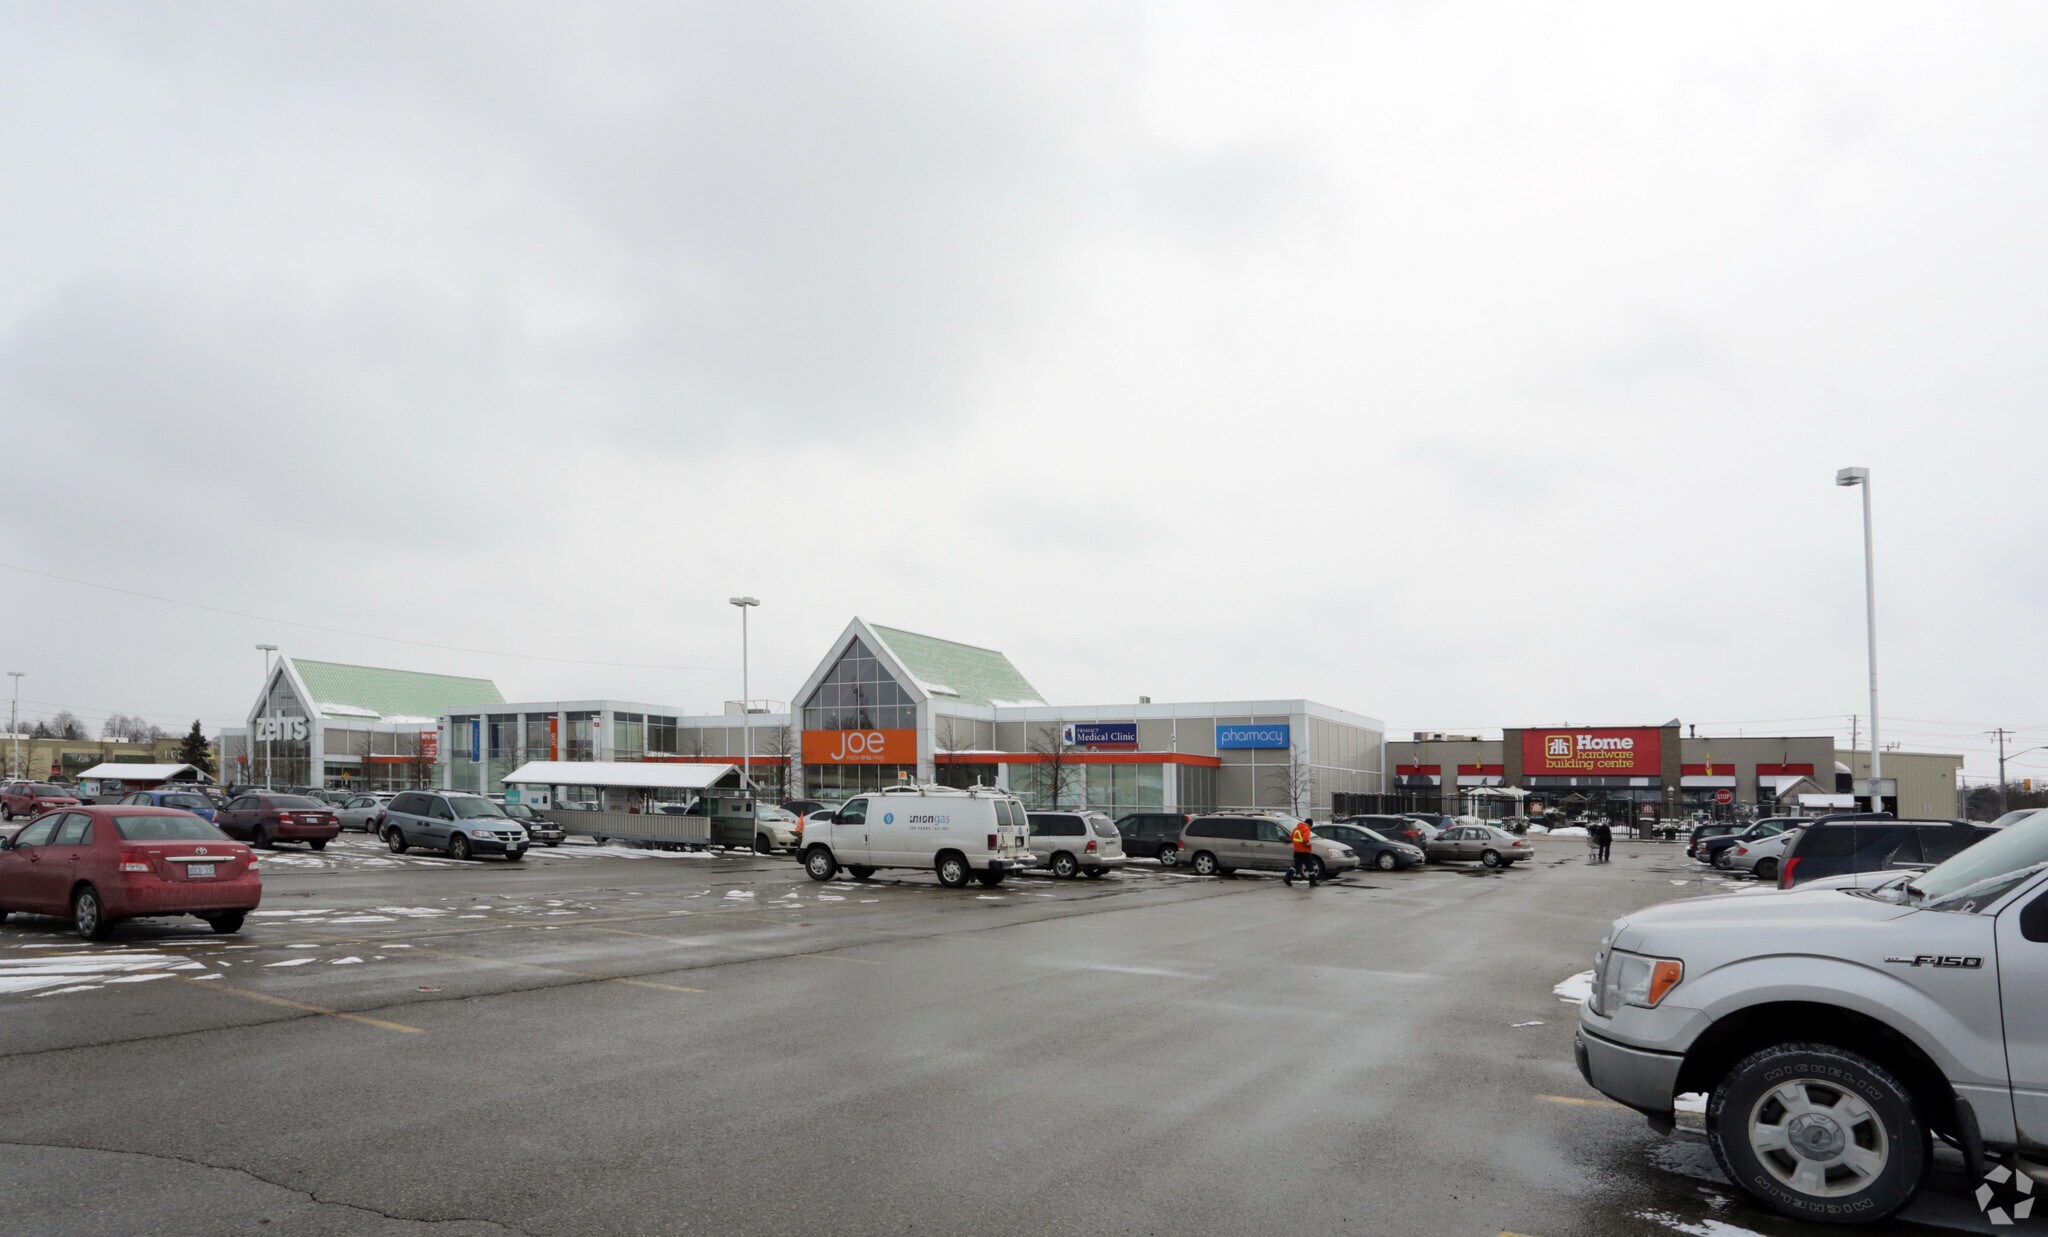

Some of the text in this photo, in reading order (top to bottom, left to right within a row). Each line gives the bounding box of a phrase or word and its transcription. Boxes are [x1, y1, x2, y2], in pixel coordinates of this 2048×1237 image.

[256, 710, 307, 741] zehrs
[1077, 732, 1135, 741] Medical Clinic
[1221, 728, 1283, 745] pharmacy
[1576, 735, 1634, 750] Home
[1577, 750, 1634, 759] hardware
[1545, 759, 1634, 770] building centre
[1913, 955, 1983, 969] F-150
[1764, 1064, 1883, 1101] MICHELIN
[1754, 1175, 1873, 1214] MICHELIN
